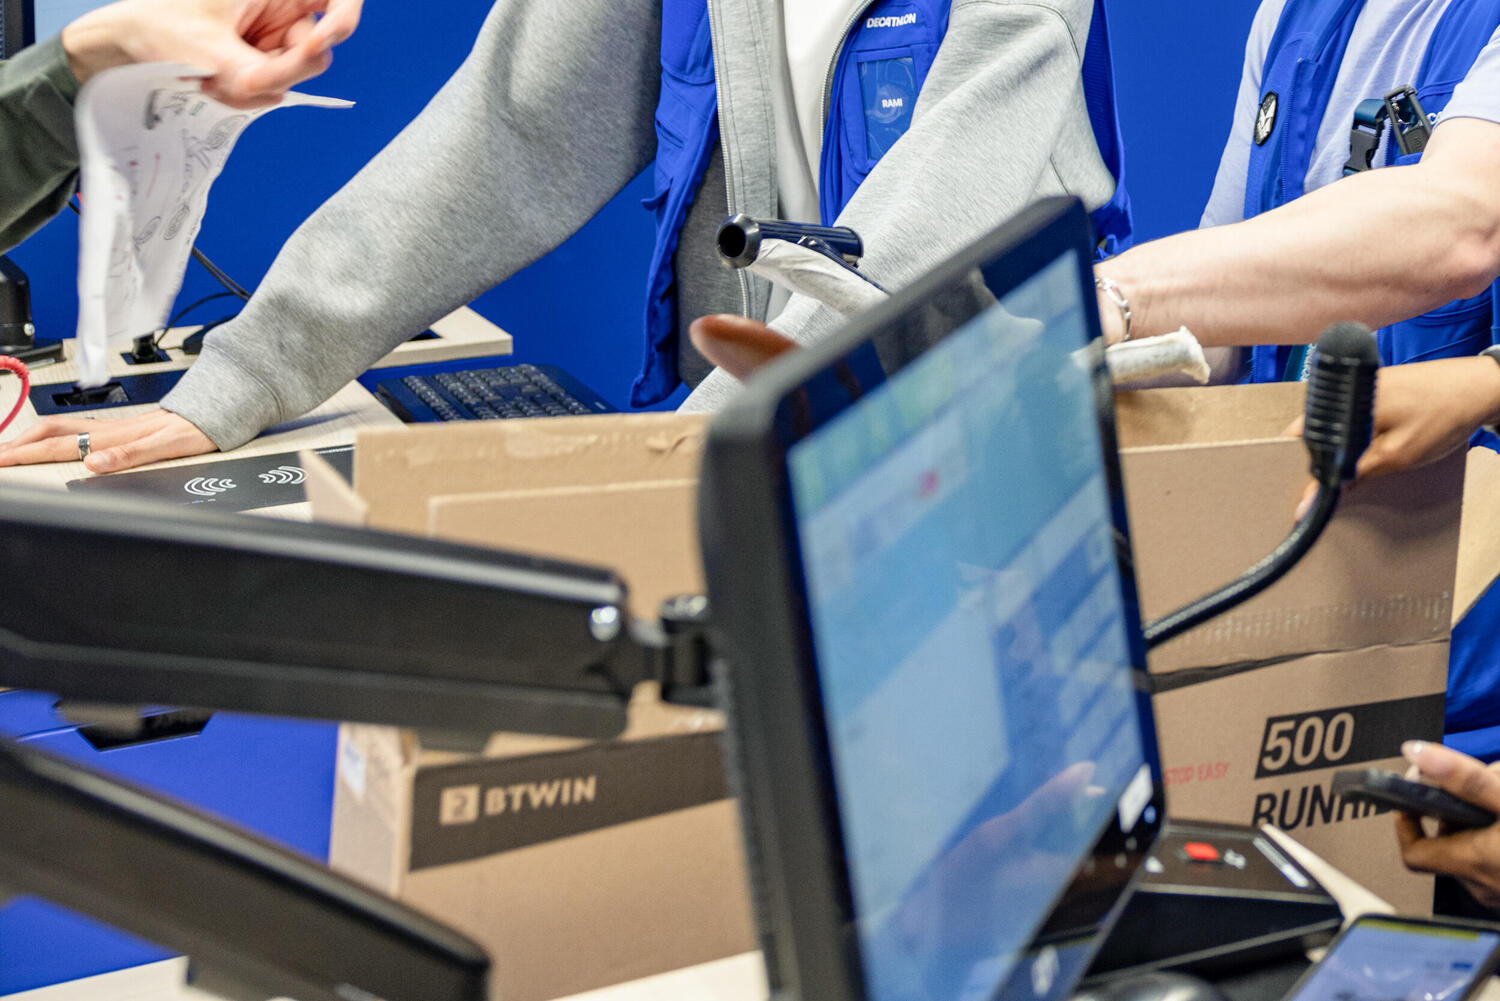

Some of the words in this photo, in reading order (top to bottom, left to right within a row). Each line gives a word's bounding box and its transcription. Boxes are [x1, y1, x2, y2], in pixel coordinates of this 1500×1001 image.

[866, 12, 916, 28] DECATHLON
[881, 98, 903, 108] RAMI
[1262, 711, 1354, 771] 500
[484, 775, 597, 816] BTWIN
